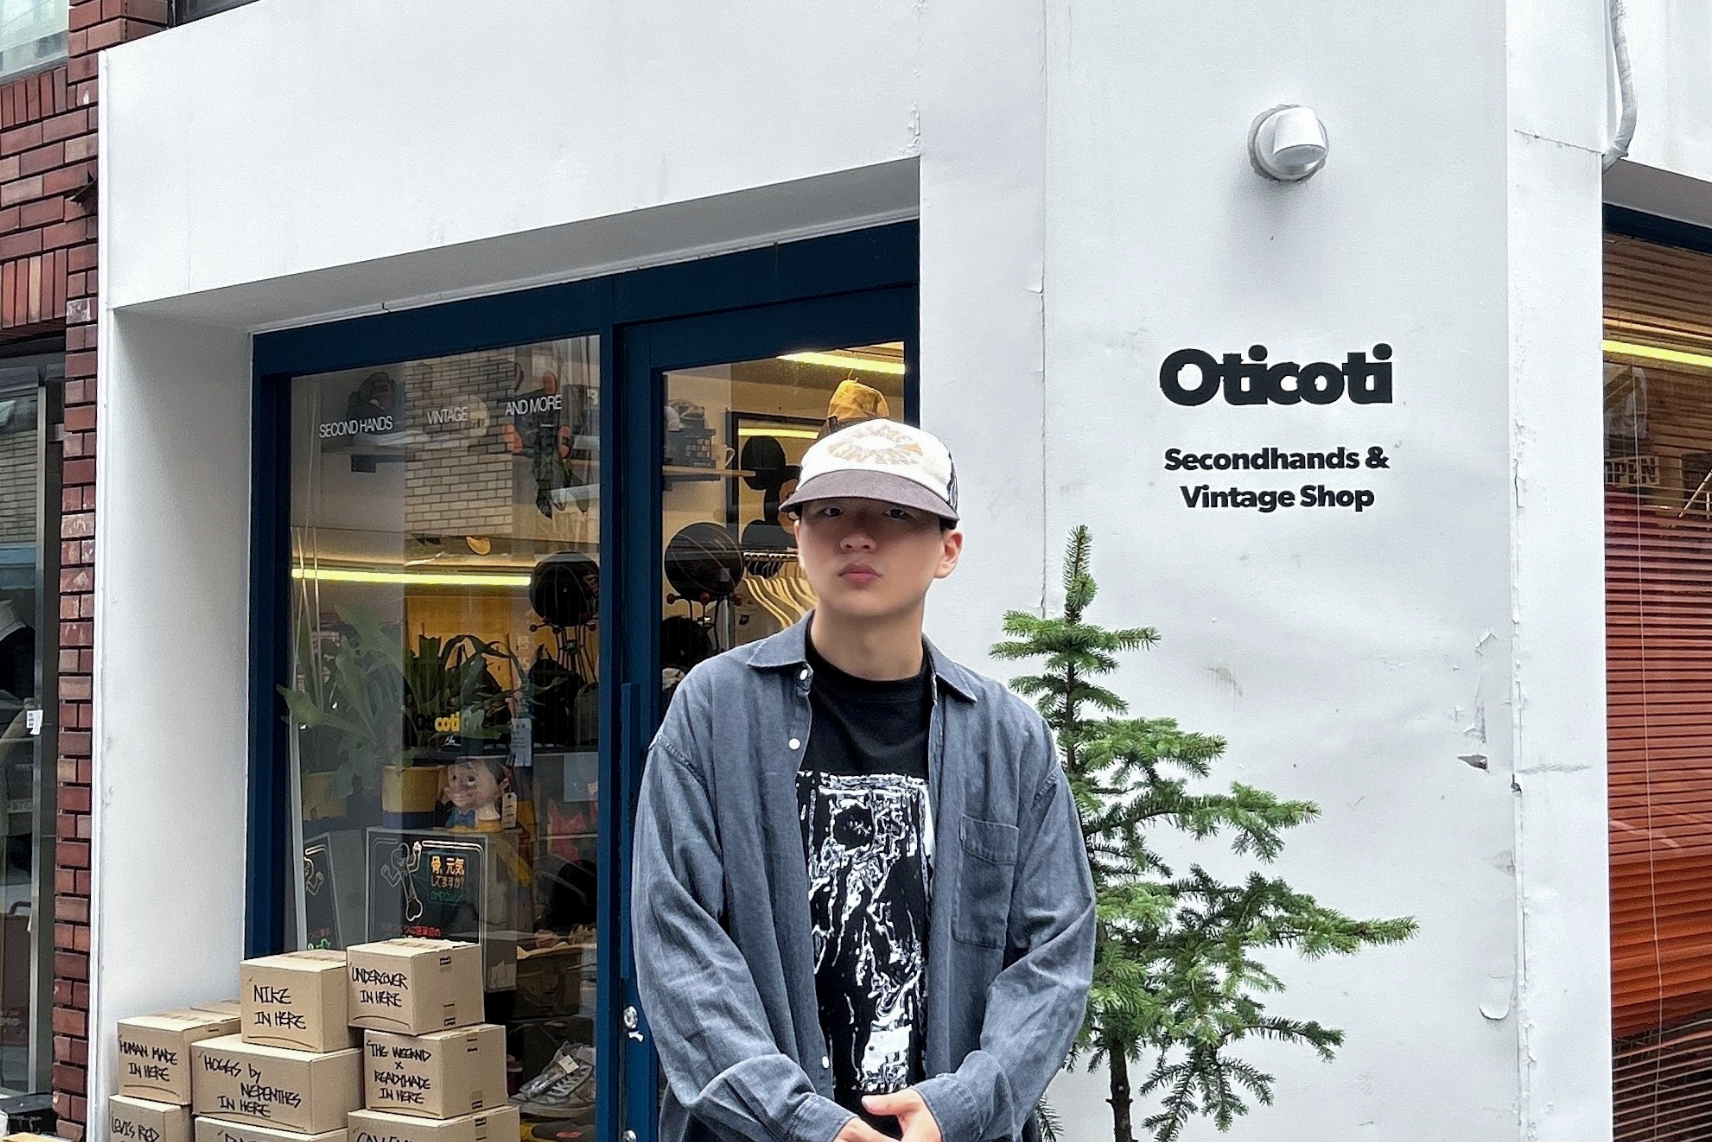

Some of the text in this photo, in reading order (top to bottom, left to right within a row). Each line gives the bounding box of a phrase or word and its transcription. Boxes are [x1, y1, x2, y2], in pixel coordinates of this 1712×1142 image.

[1160, 342, 1393, 406] Oticoti
[427, 406, 468, 424] VINTAGE
[505, 394, 562, 416] AND MORE
[319, 416, 393, 438] SECOND HANDS
[1164, 446, 1390, 471] Secondhands &
[1180, 484, 1375, 513] Vintage Shop
[352, 966, 408, 990] UNDERCOVER
[253, 984, 292, 1005] NIKE
[359, 990, 402, 1008] IN HERE
[254, 1011, 307, 1029] IN HERE
[119, 1040, 178, 1066] HUMAN MADE
[366, 1043, 389, 1057] THE
[128, 1062, 170, 1082] IN HERE
[373, 1070, 431, 1090] READYMADE
[240, 1082, 302, 1108] NEPENTHES
[378, 1087, 425, 1104] IN HERE
[217, 1095, 271, 1118] IN HERE
